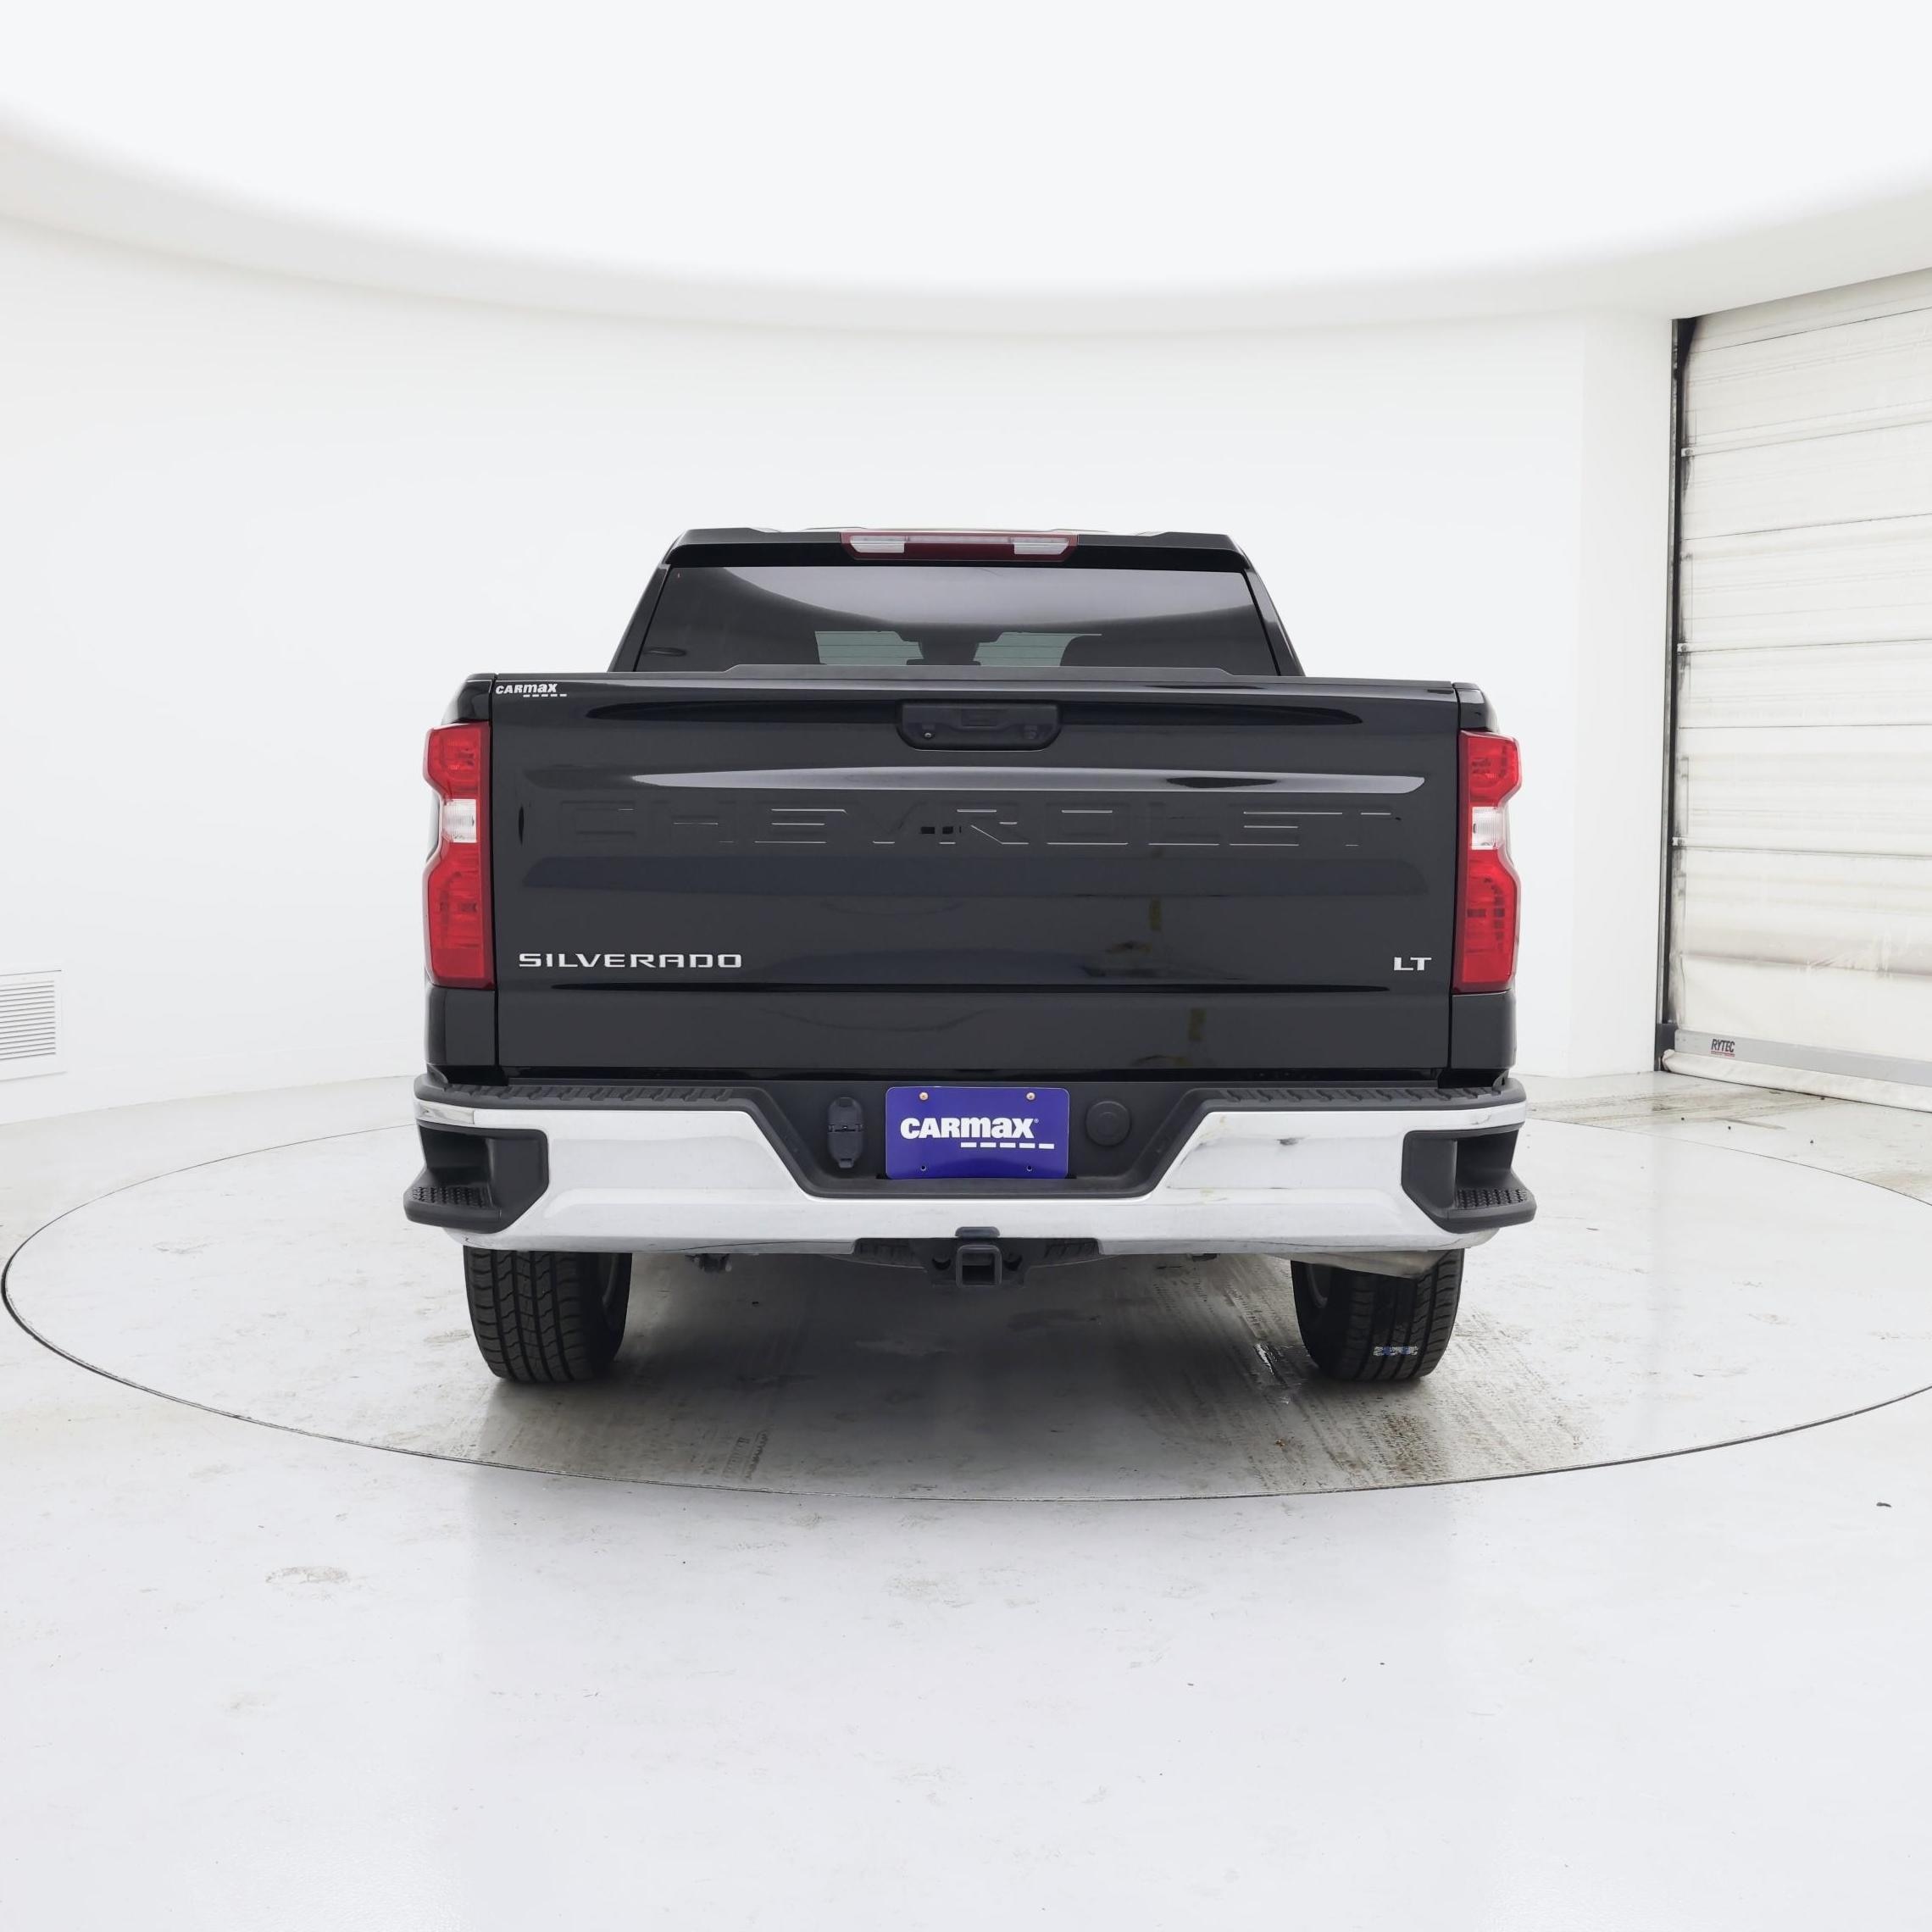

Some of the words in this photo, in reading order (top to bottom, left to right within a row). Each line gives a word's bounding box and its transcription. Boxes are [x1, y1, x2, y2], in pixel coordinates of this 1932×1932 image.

[519, 952, 742, 969] SILVERADO
[1394, 957, 1432, 971] LT
[1711, 1038, 1735, 1053] RYTEC
